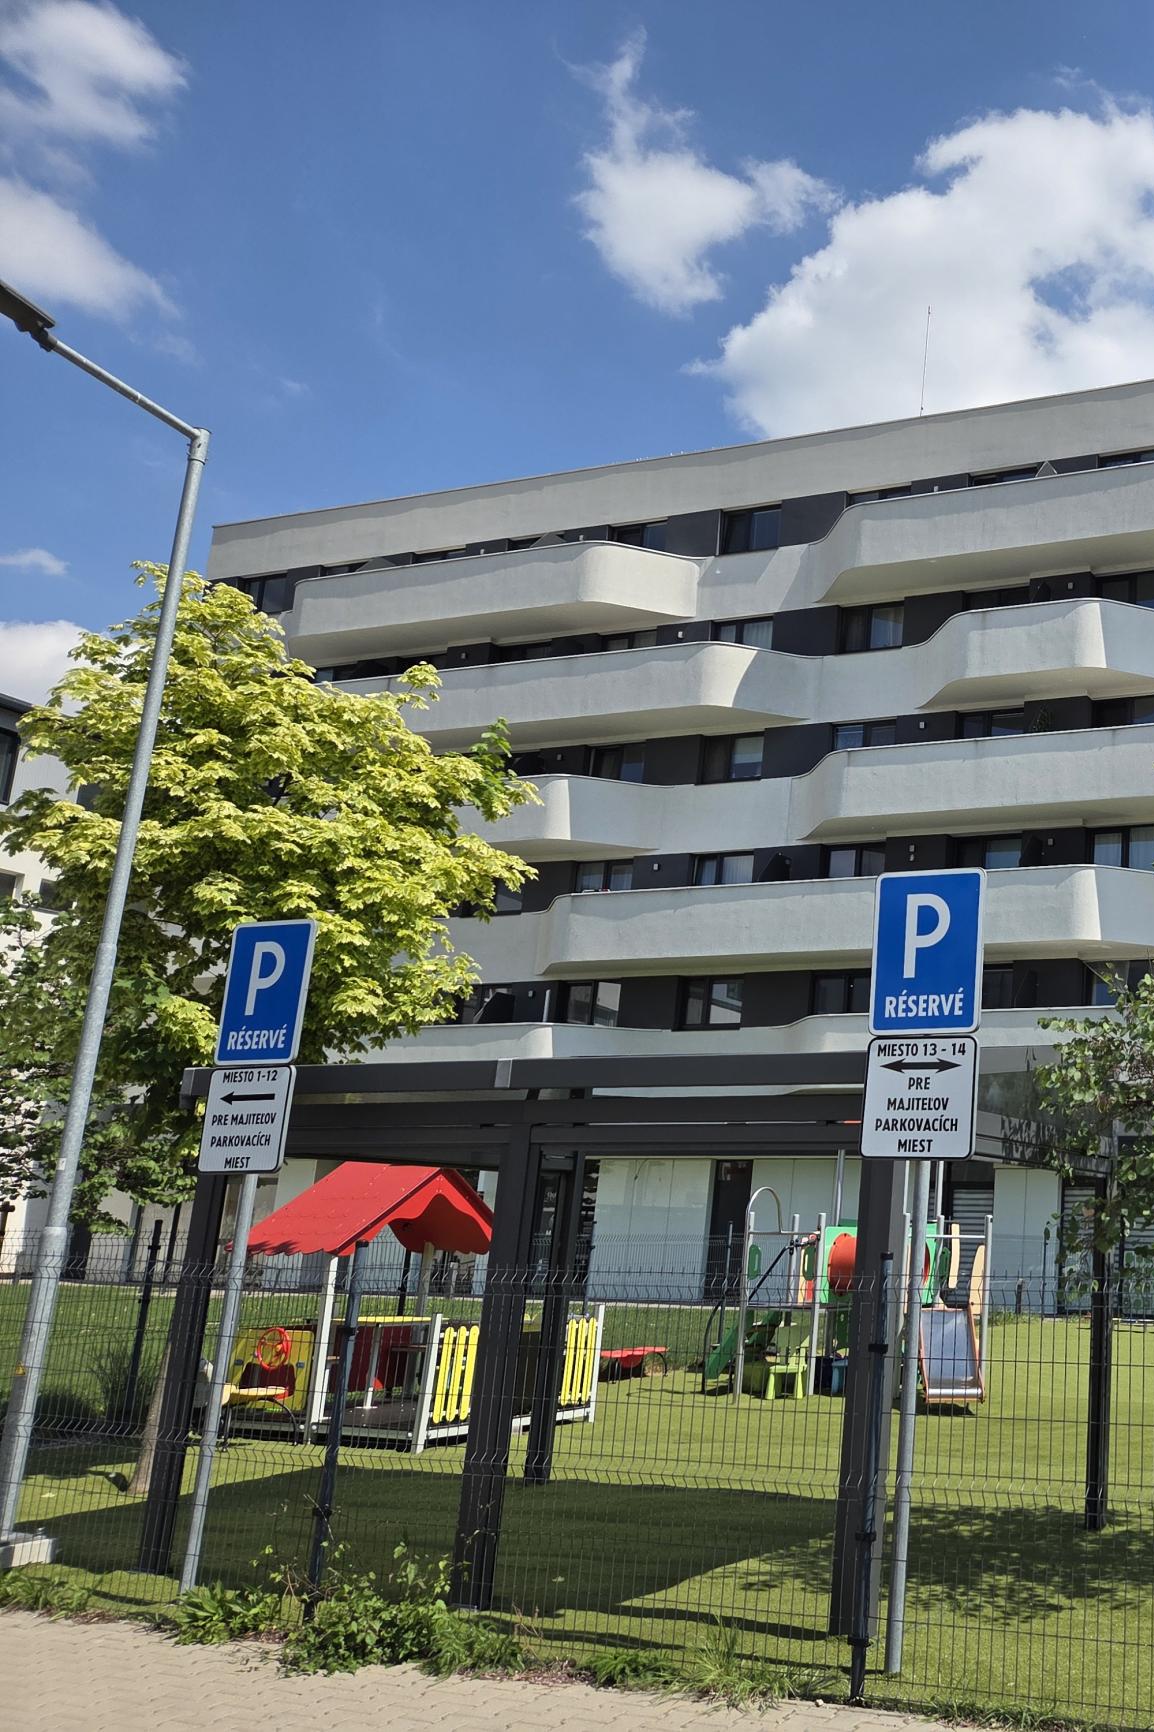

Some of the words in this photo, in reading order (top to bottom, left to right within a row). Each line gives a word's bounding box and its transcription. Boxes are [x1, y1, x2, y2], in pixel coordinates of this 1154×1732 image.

[903, 893, 951, 979] P
[244, 941, 286, 1016] P
[884, 987, 964, 1018] RÉSERVÉ
[227, 1024, 287, 1051] RÉSERVÉ
[877, 1043, 921, 1057] MIESTO
[923, 1043, 939, 1056] 13
[951, 1042, 966, 1056] 14
[222, 1070, 255, 1084] MIESTO
[256, 1070, 278, 1082] 1-12
[908, 1077, 931, 1090] PRE
[887, 1097, 949, 1111] MAJITEĽOV
[211, 1114, 229, 1126] PRE
[230, 1112, 277, 1125] MAJITEĽOV
[874, 1115, 959, 1132] PARKOVACÍCH
[210, 1131, 271, 1147] PARKOVACÍCH
[897, 1138, 934, 1153] MIEST
[224, 1156, 251, 1170] MIEST
